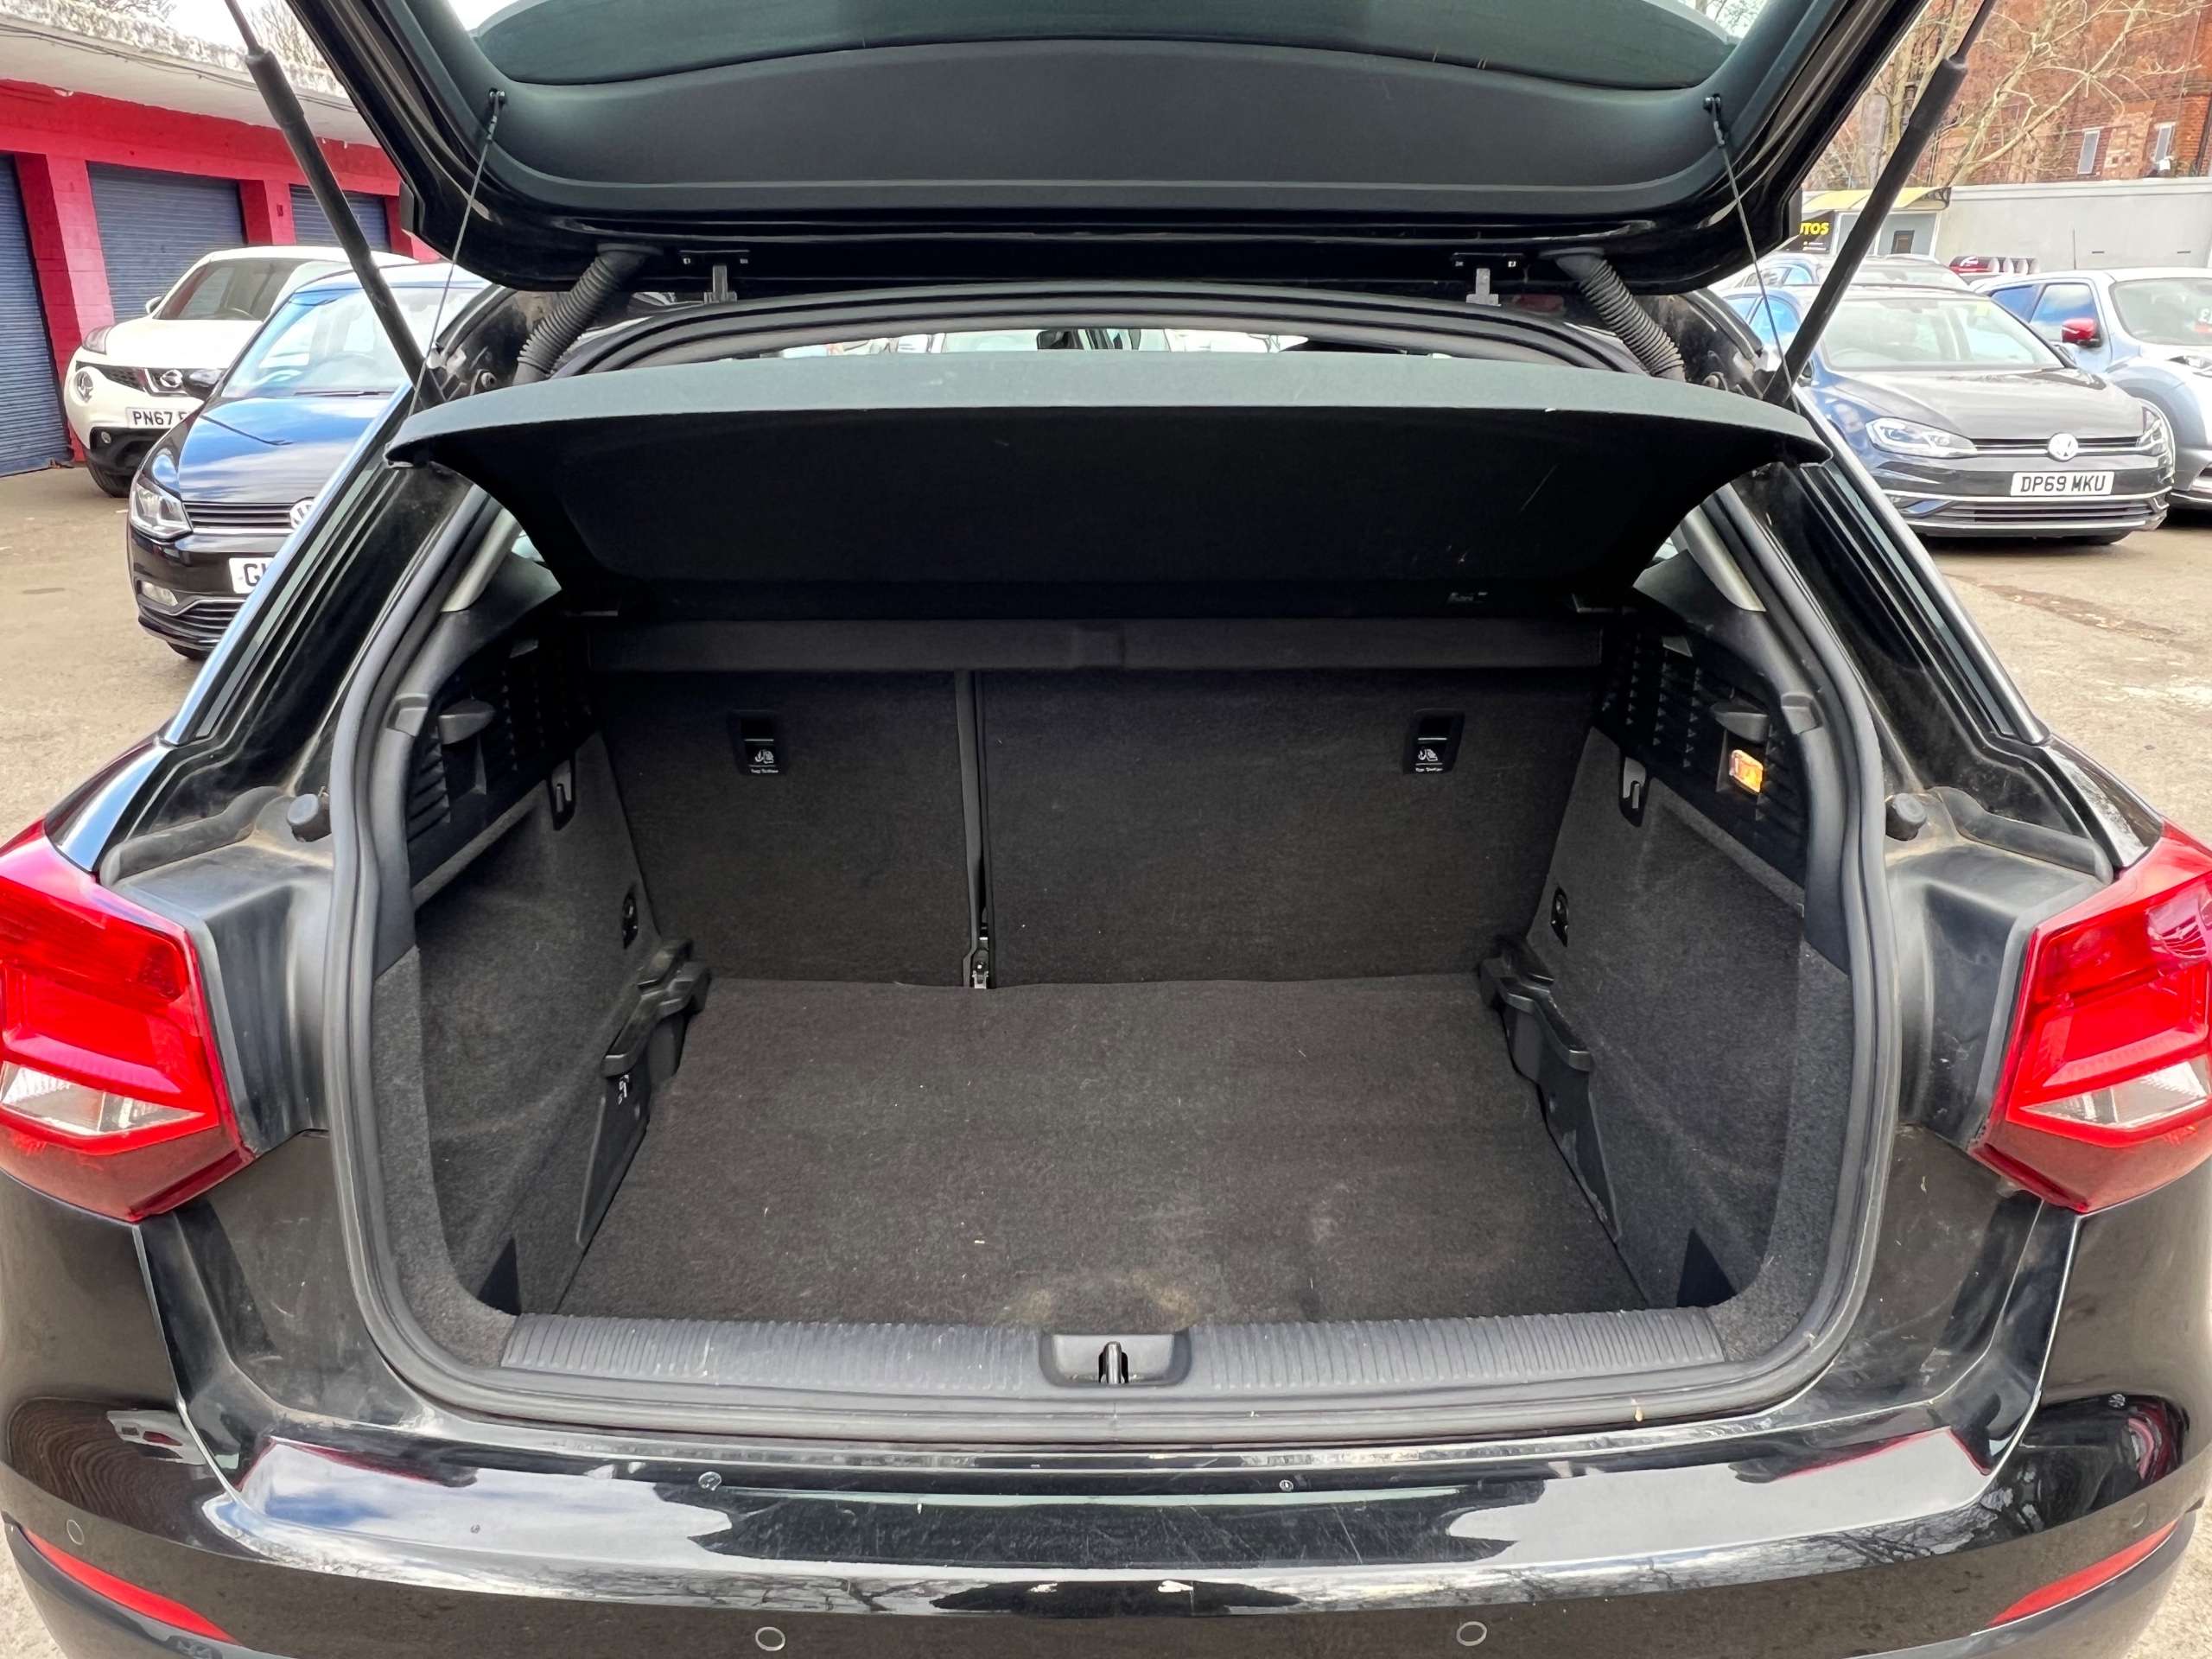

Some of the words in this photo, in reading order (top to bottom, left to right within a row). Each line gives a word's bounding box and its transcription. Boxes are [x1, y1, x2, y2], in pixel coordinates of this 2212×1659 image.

[132, 410, 173, 425] PN67
[2020, 475, 2068, 493] DP69
[2071, 474, 2106, 492] MKU
